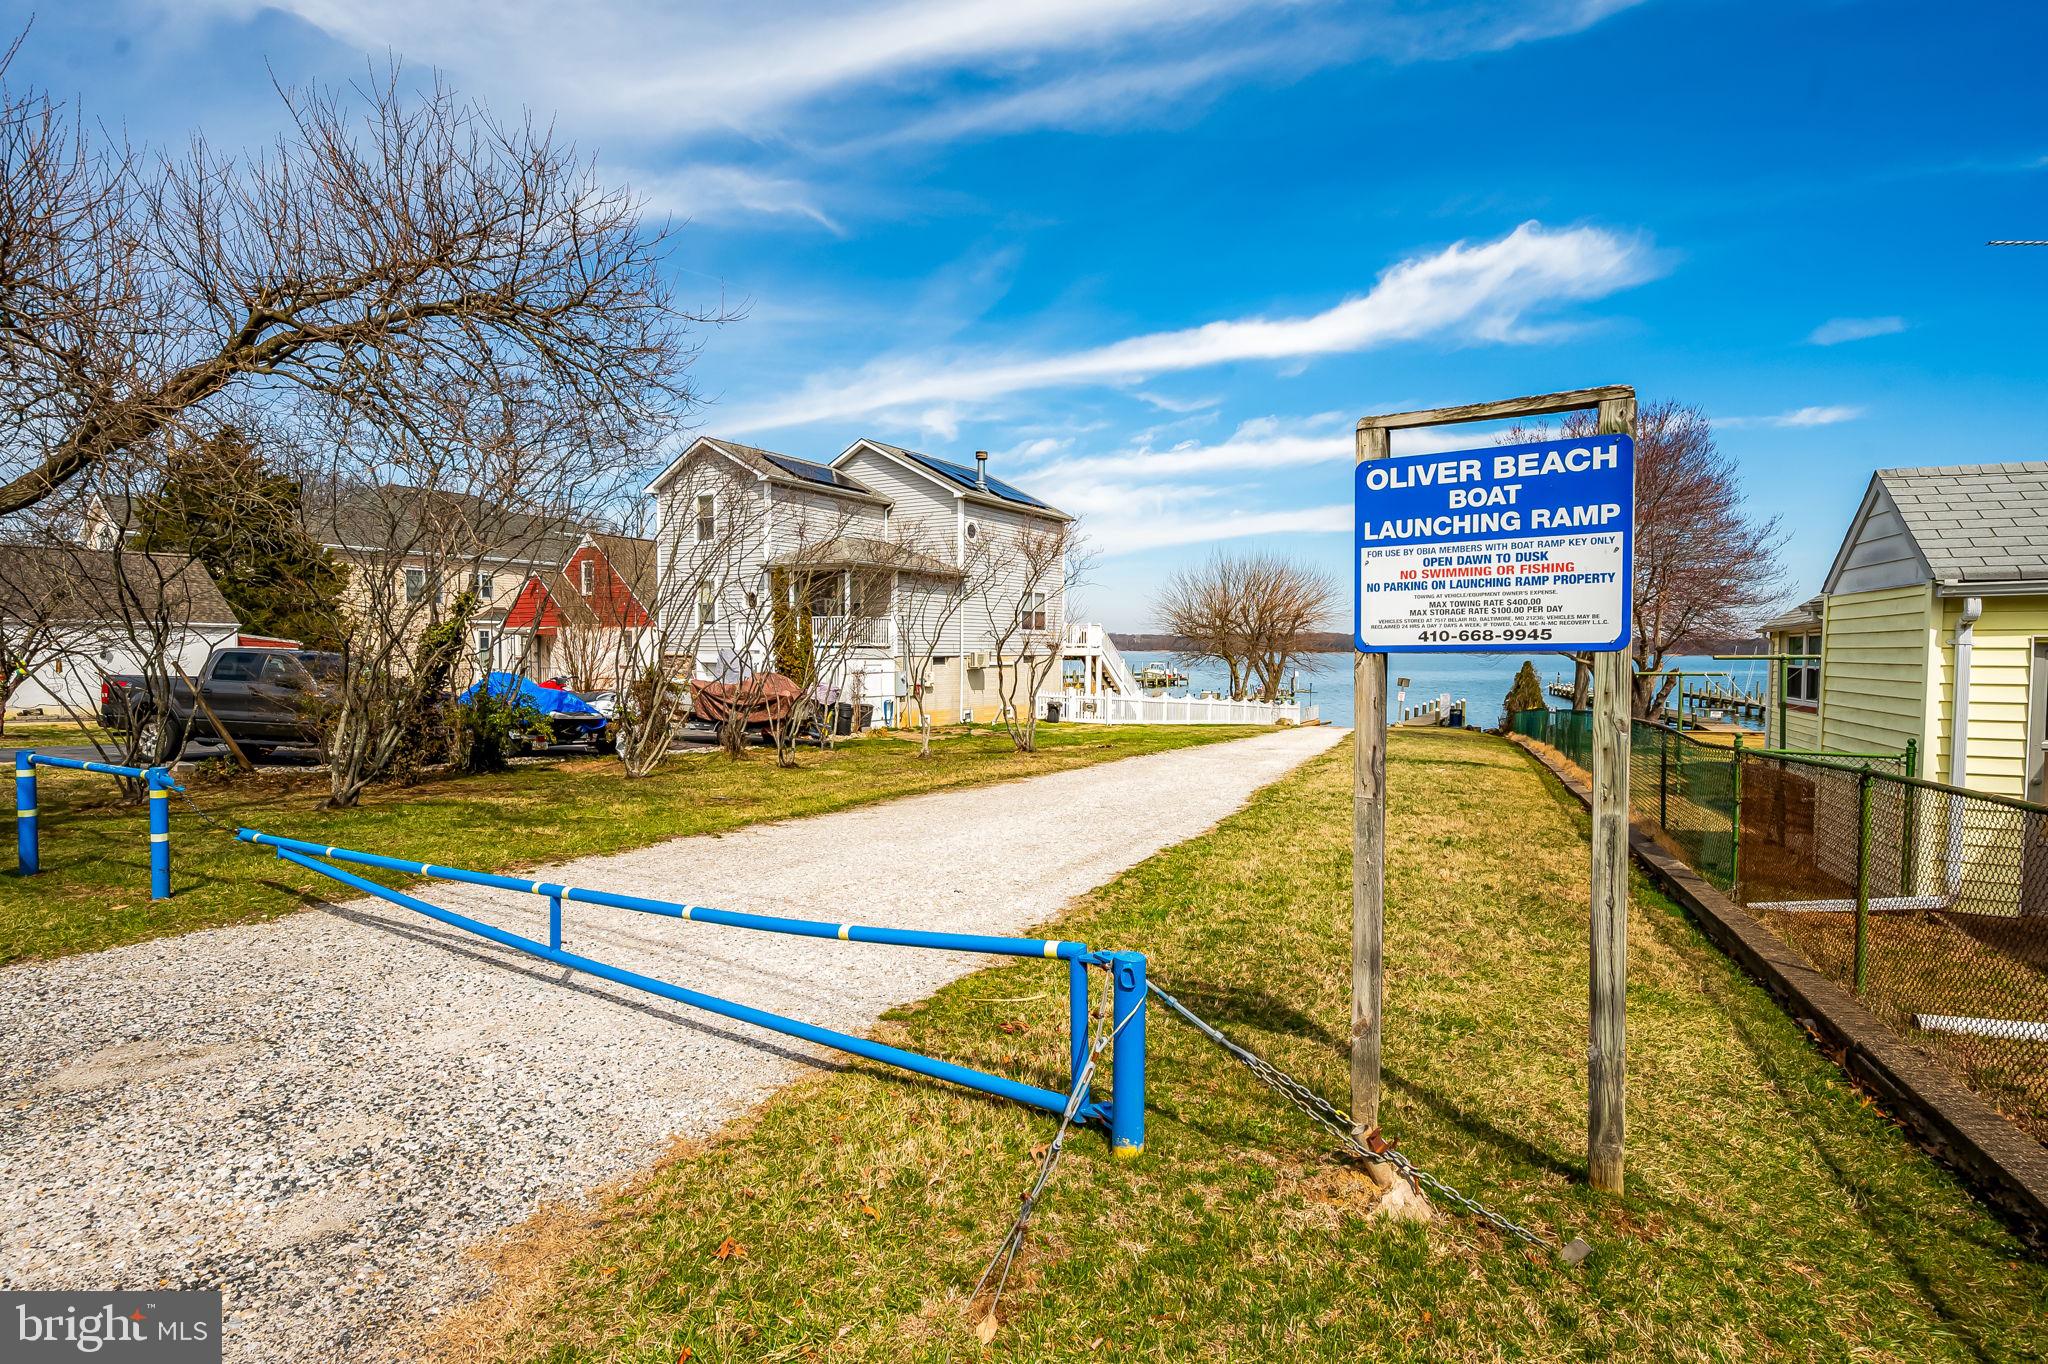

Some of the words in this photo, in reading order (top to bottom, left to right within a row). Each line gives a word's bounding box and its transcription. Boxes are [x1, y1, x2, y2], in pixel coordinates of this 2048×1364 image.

[1366, 460, 1481, 491] OLIVER
[1494, 445, 1618, 479] BEACH
[1449, 485, 1522, 509] BOAT
[1364, 512, 1521, 540] LAUNCHING
[1531, 504, 1620, 529] RAMP
[1368, 549, 1382, 558] FOR
[1439, 545, 1482, 554] MEMBERS
[1511, 541, 1534, 550] BOAT
[1537, 539, 1565, 548] RAMP
[1569, 538, 1587, 546] KEY
[1590, 536, 1615, 545] ONLY
[1423, 557, 1452, 567] OPEN
[1457, 554, 1491, 565] DAWN
[1496, 553, 1510, 563] TO
[1516, 551, 1548, 562] DUSK
[1400, 570, 1417, 580] NO
[1422, 566, 1491, 578] SWIMMING
[1497, 565, 1514, 575] OR
[1520, 562, 1574, 574] FISHING
[1367, 583, 1380, 592] NO
[1384, 580, 1427, 591] PARKING
[1432, 580, 1445, 590] ON
[1450, 577, 1511, 589] LAUNCHING
[1516, 576, 1549, 586] RAMP
[1554, 573, 1615, 585] PROPERTY
[1491, 606, 1524, 614] $100.00
[1418, 629, 1552, 642] 410-668-9945
